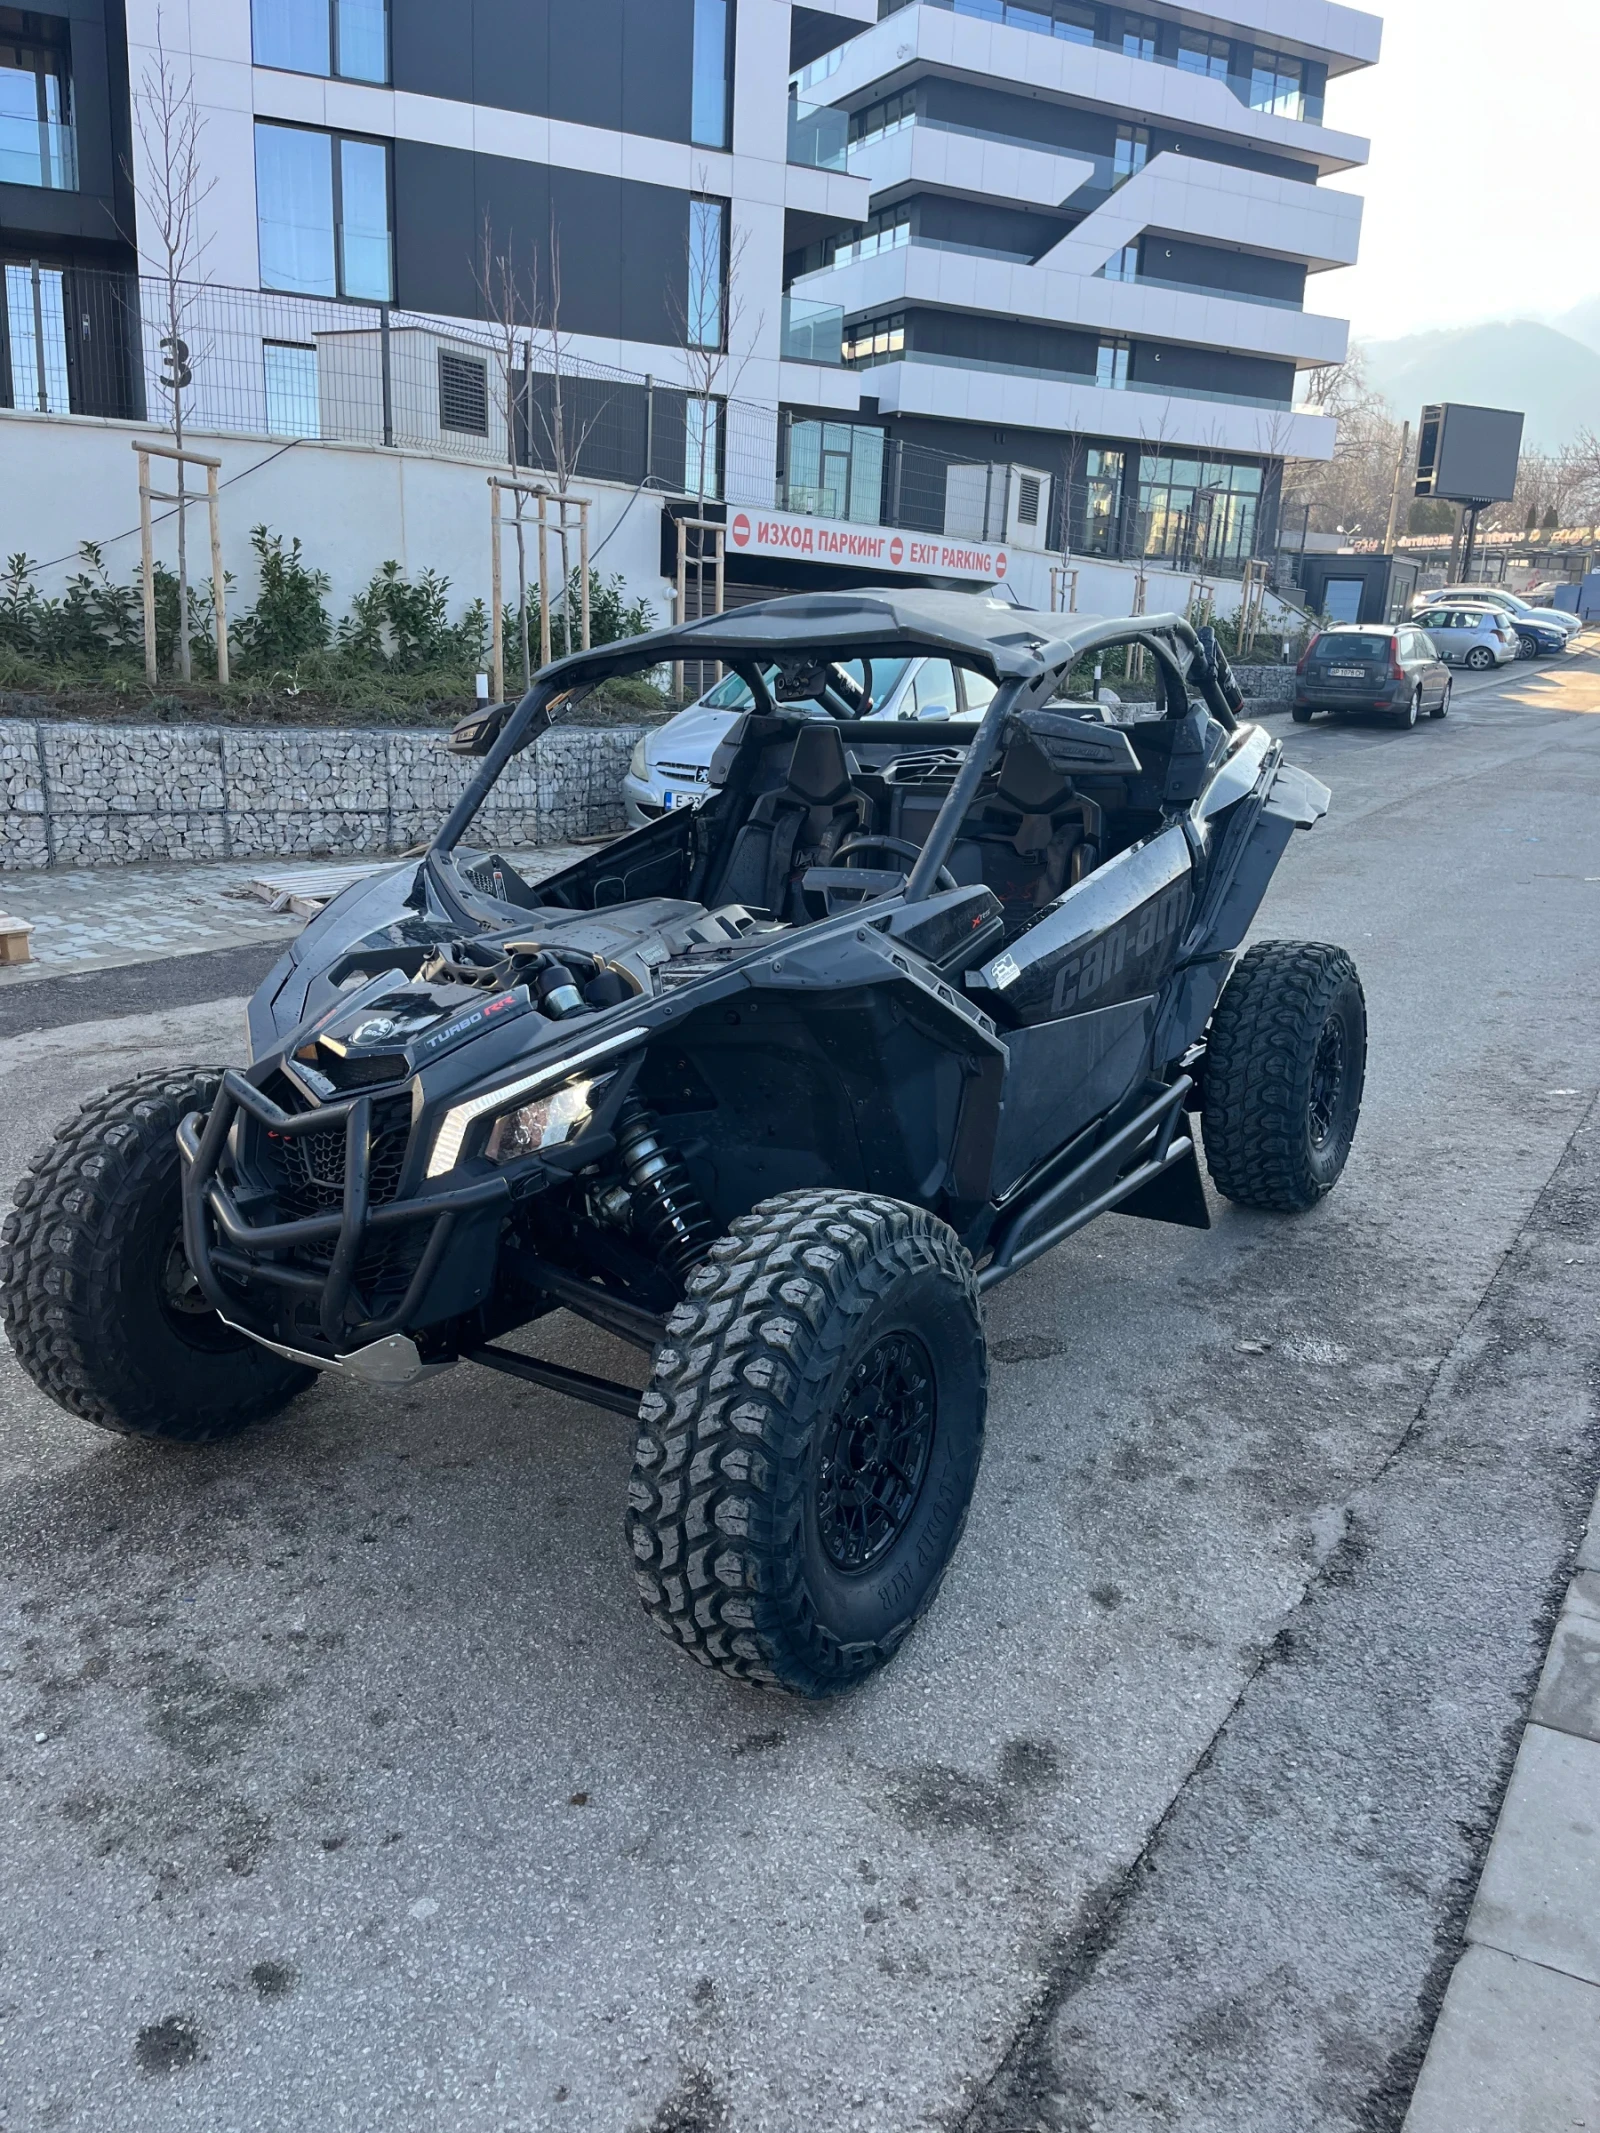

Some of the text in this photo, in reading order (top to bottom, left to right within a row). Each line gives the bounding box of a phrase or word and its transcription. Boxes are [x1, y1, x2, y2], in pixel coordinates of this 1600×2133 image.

[159, 337, 192, 388] 3
[757, 521, 886, 558] ИЗХОД ПАРКИНГ
[910, 542, 991, 572] EXIT PARKING
[363, 1029, 383, 1037] BRP
[426, 995, 516, 1048] TURBO RR
